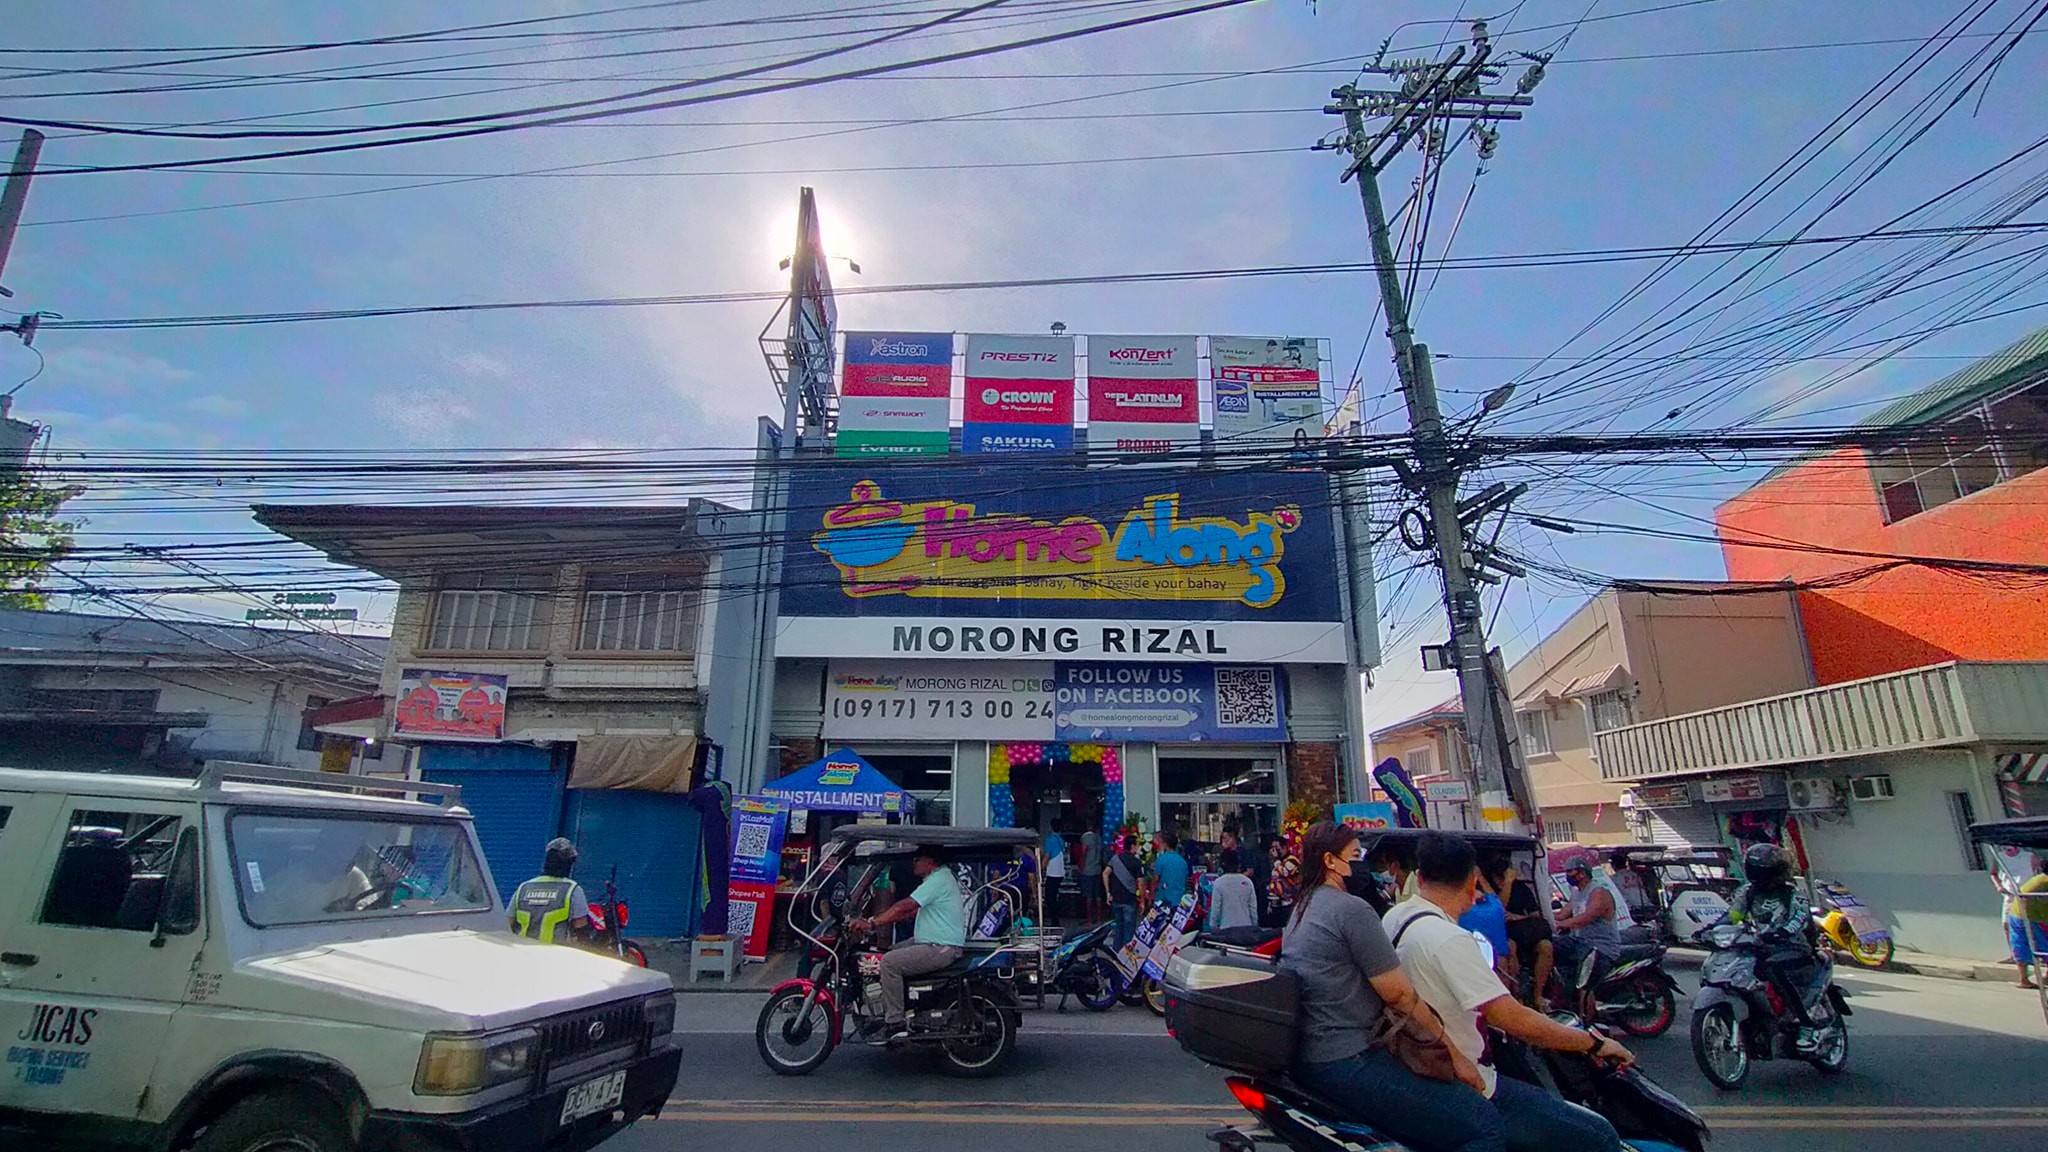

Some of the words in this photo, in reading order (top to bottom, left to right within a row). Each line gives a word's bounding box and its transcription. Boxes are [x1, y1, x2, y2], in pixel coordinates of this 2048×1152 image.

[1001, 391, 1054, 404] CROWN
[1116, 393, 1182, 404] PLATINUM
[981, 436, 1056, 449] SAKURA
[924, 505, 1103, 563] Home
[1115, 499, 1276, 603] Along
[1107, 576, 1150, 590] beside
[1154, 578, 1185, 591] your
[1187, 577, 1227, 591] bahay
[893, 625, 1080, 654] MORONG
[1102, 626, 1228, 654] RIZAL
[905, 678, 967, 690] MORONG
[970, 678, 1008, 690] RIZAL
[1068, 668, 1150, 684] FOLLOW
[1158, 669, 1184, 684] US
[1056, 687, 1087, 704] ON
[1094, 687, 1203, 704] FACEBOOK
[833, 697, 916, 720] (0917)
[927, 699, 973, 719] 713
[984, 699, 1013, 719] 00
[1025, 700, 1054, 720] 24
[780, 790, 883, 807] INSTALLMENT
